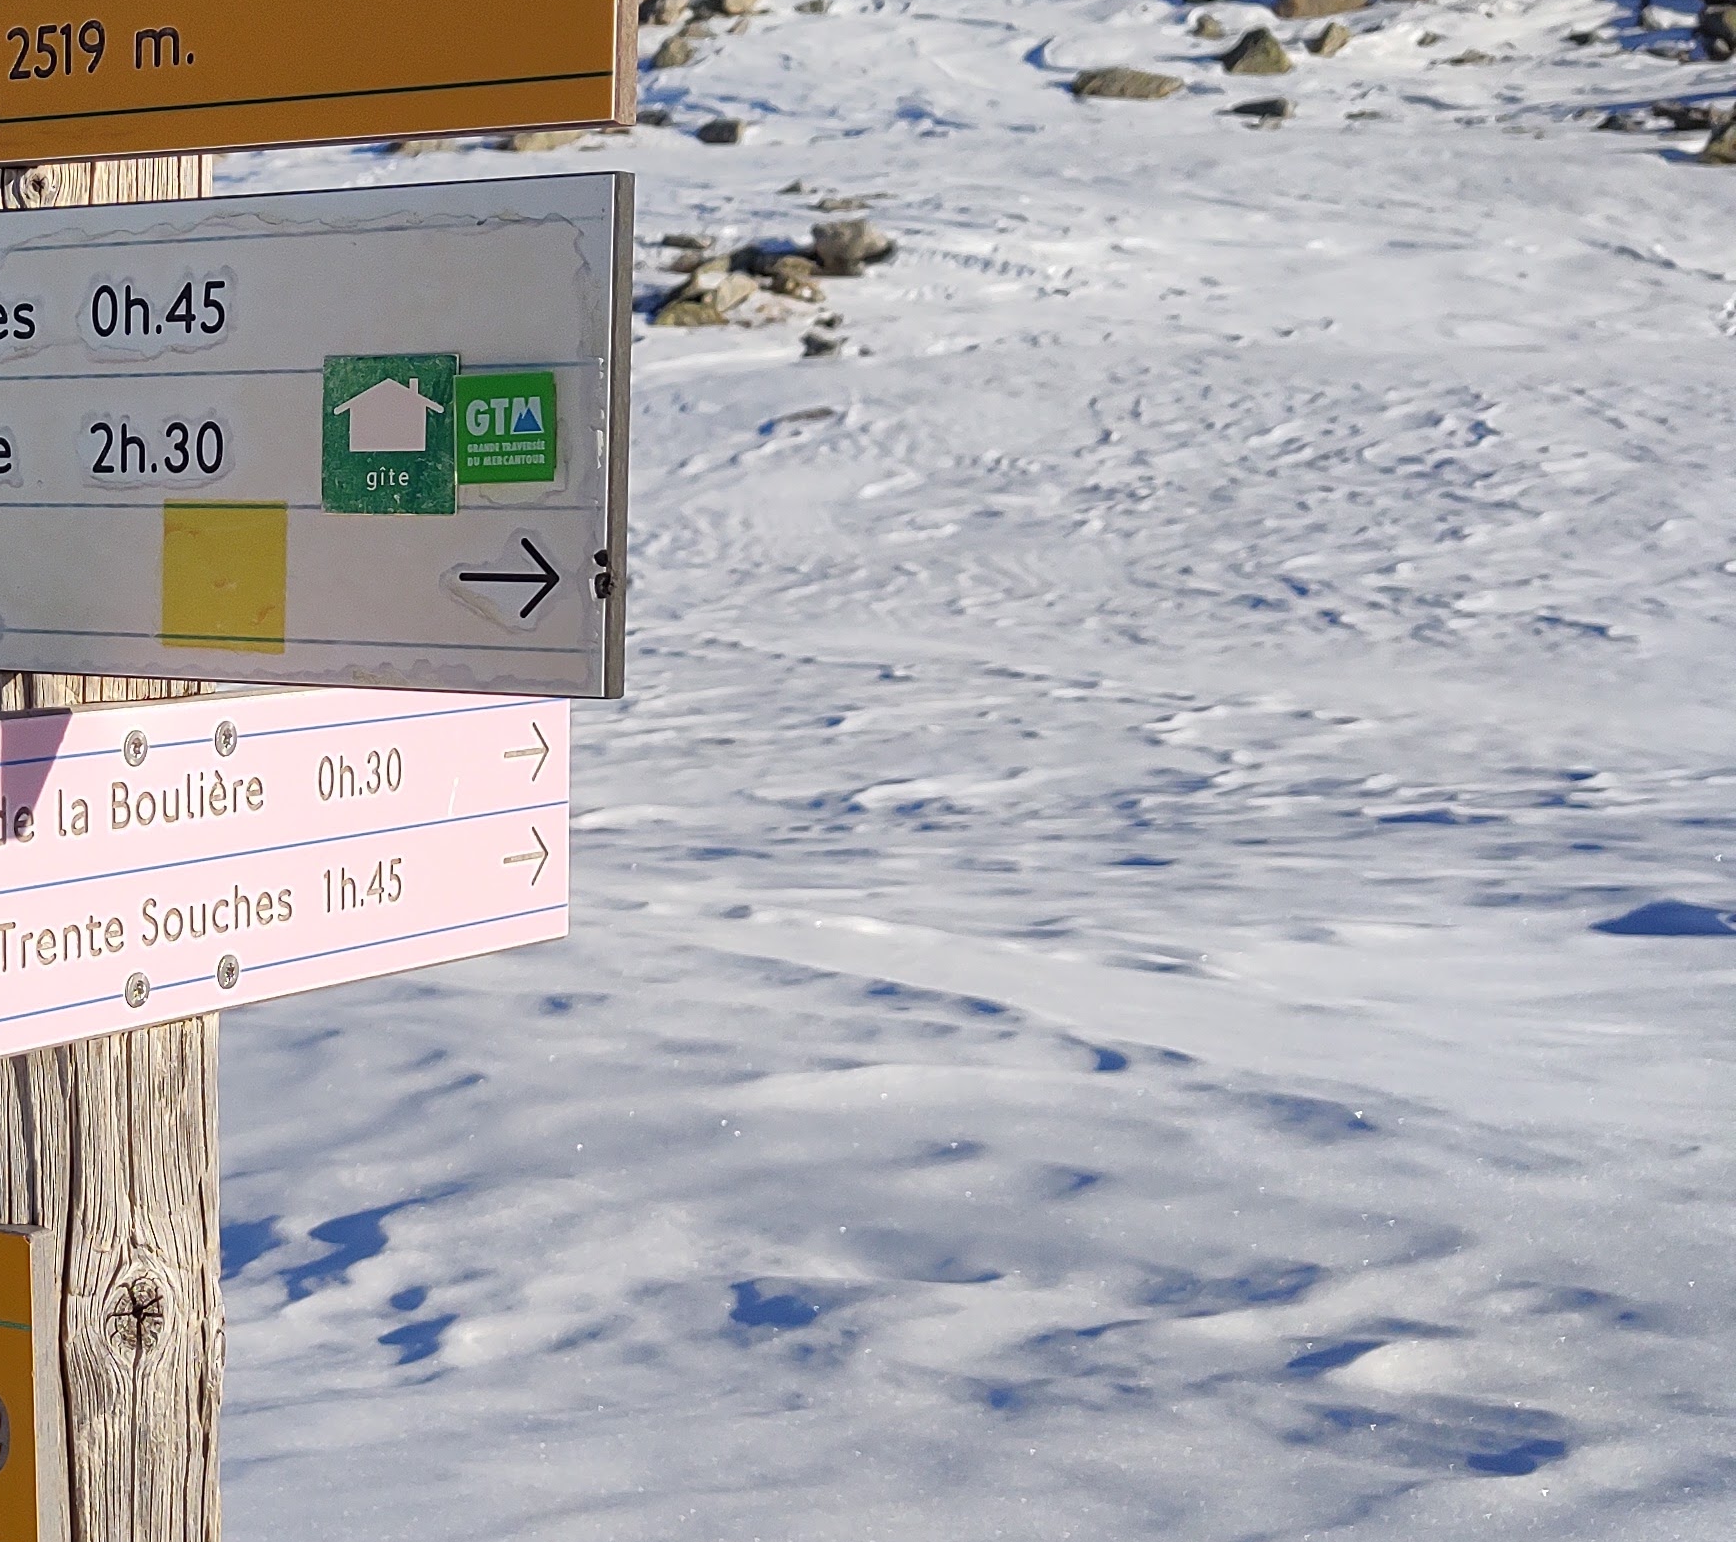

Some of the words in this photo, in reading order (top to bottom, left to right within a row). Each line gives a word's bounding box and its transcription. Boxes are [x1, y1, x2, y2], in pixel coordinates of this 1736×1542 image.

[6, 19, 106, 80] 2519
[134, 24, 196, 69] m.
[90, 280, 227, 337] 0h.45
[466, 397, 544, 436] GTM
[90, 420, 225, 475] 2h.30
[467, 456, 481, 467] DU
[483, 454, 545, 466] MERCANTOUR
[366, 466, 410, 490] gîte
[58, 788, 89, 837] la
[111, 770, 264, 830] Boulière
[317, 747, 403, 801] 0h.30
[141, 885, 293, 945] Souches
[322, 857, 403, 913] 1h.45
